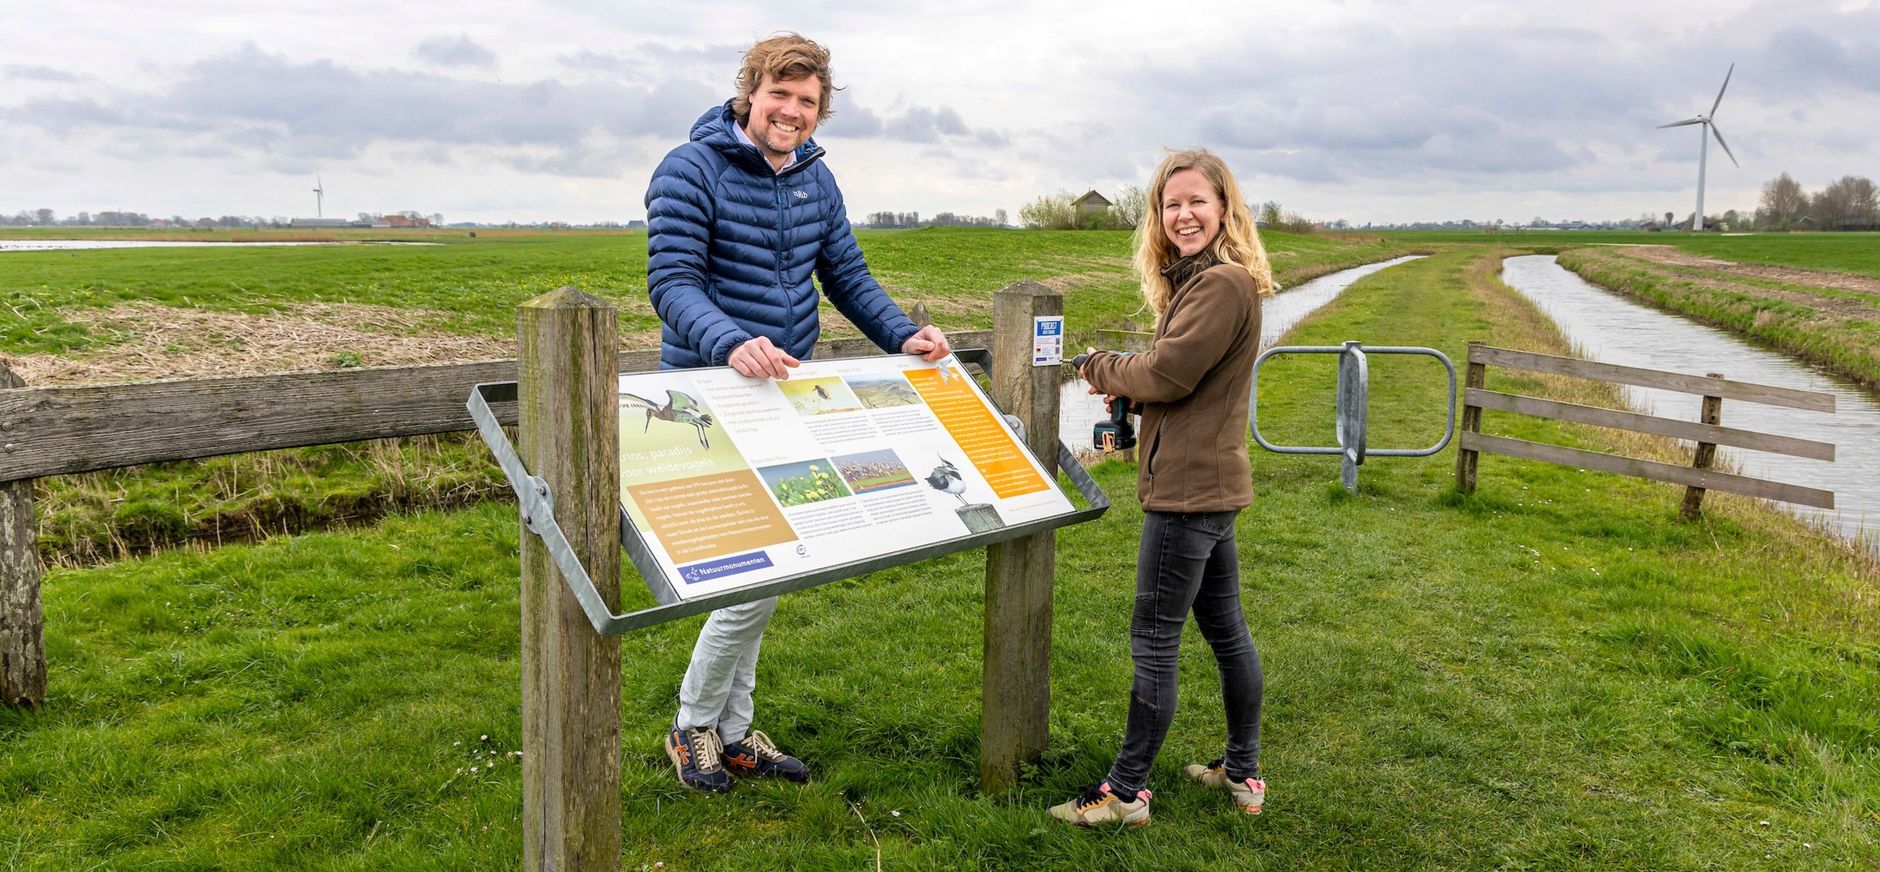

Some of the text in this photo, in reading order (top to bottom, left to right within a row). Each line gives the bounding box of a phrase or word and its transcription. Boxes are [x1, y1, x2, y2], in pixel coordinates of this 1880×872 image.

[651, 445, 692, 459] paradijs
[647, 458, 713, 474] weidevogels
[699, 557, 766, 575] Natuurmonumenten
